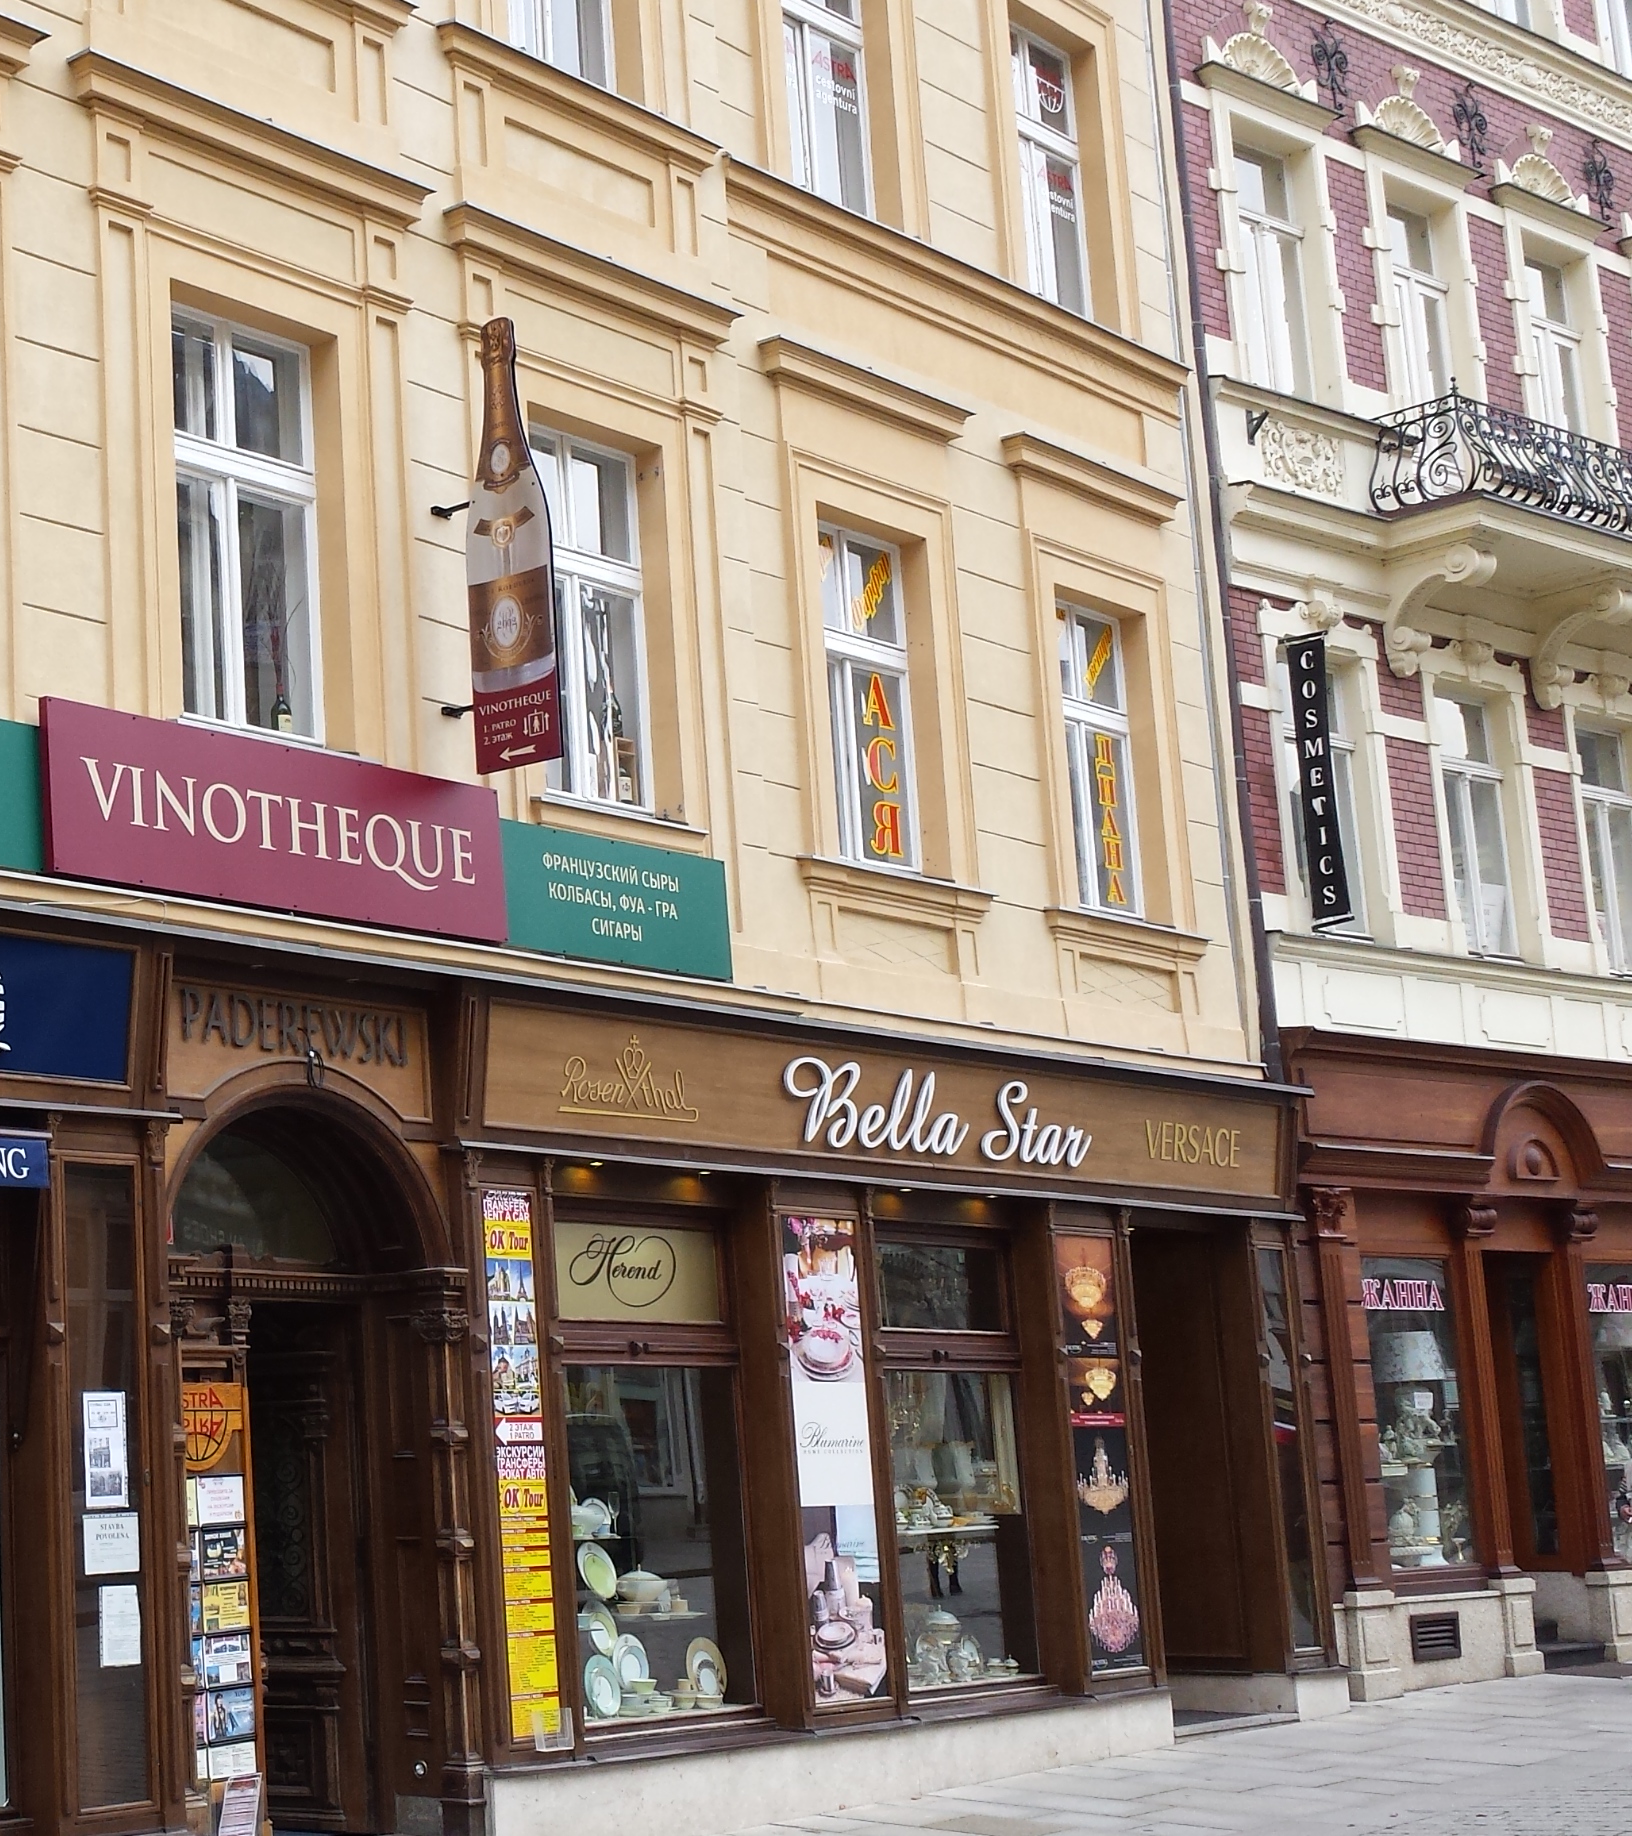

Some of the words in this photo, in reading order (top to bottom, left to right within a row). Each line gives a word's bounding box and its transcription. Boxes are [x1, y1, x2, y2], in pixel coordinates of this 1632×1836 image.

[815, 89, 858, 115] agentura
[478, 689, 552, 717] VINOTHEQUE
[491, 718, 517, 732] PATRO
[863, 672, 904, 858] АСЯ
[1299, 650, 1337, 906] COSMETICS
[79, 756, 477, 892] VINOTHEQUE
[542, 852, 639, 886] ФРАНЦУЗСКИЙ
[641, 870, 680, 893] СЫРЫ
[548, 881, 617, 912] КОЛБАСЫ,
[619, 895, 646, 915] ФУА
[655, 901, 678, 920] ГРА
[591, 917, 643, 942] СИГАРЫ
[181, 986, 409, 1068] PADEREWSKI
[782, 1055, 970, 1157] Bella
[980, 1079, 1093, 1168] Star
[1145, 1118, 1242, 1168] VERSACE
[512, 1211, 530, 1223] CAR
[490, 1229, 505, 1250] OK
[509, 1231, 529, 1251] Tour
[1360, 1278, 1445, 1311] ЖАННА
[1586, 1283, 1632, 1313] ЖАН
[183, 1386, 224, 1409] STRA
[515, 1423, 534, 1432] ЭТАЖ
[515, 1431, 535, 1440] PATRO
[496, 1445, 545, 1459] ЭКСКУРСИИ
[526, 1468, 546, 1480] АВТО
[504, 1488, 520, 1509] OK
[523, 1488, 544, 1508] Tour
